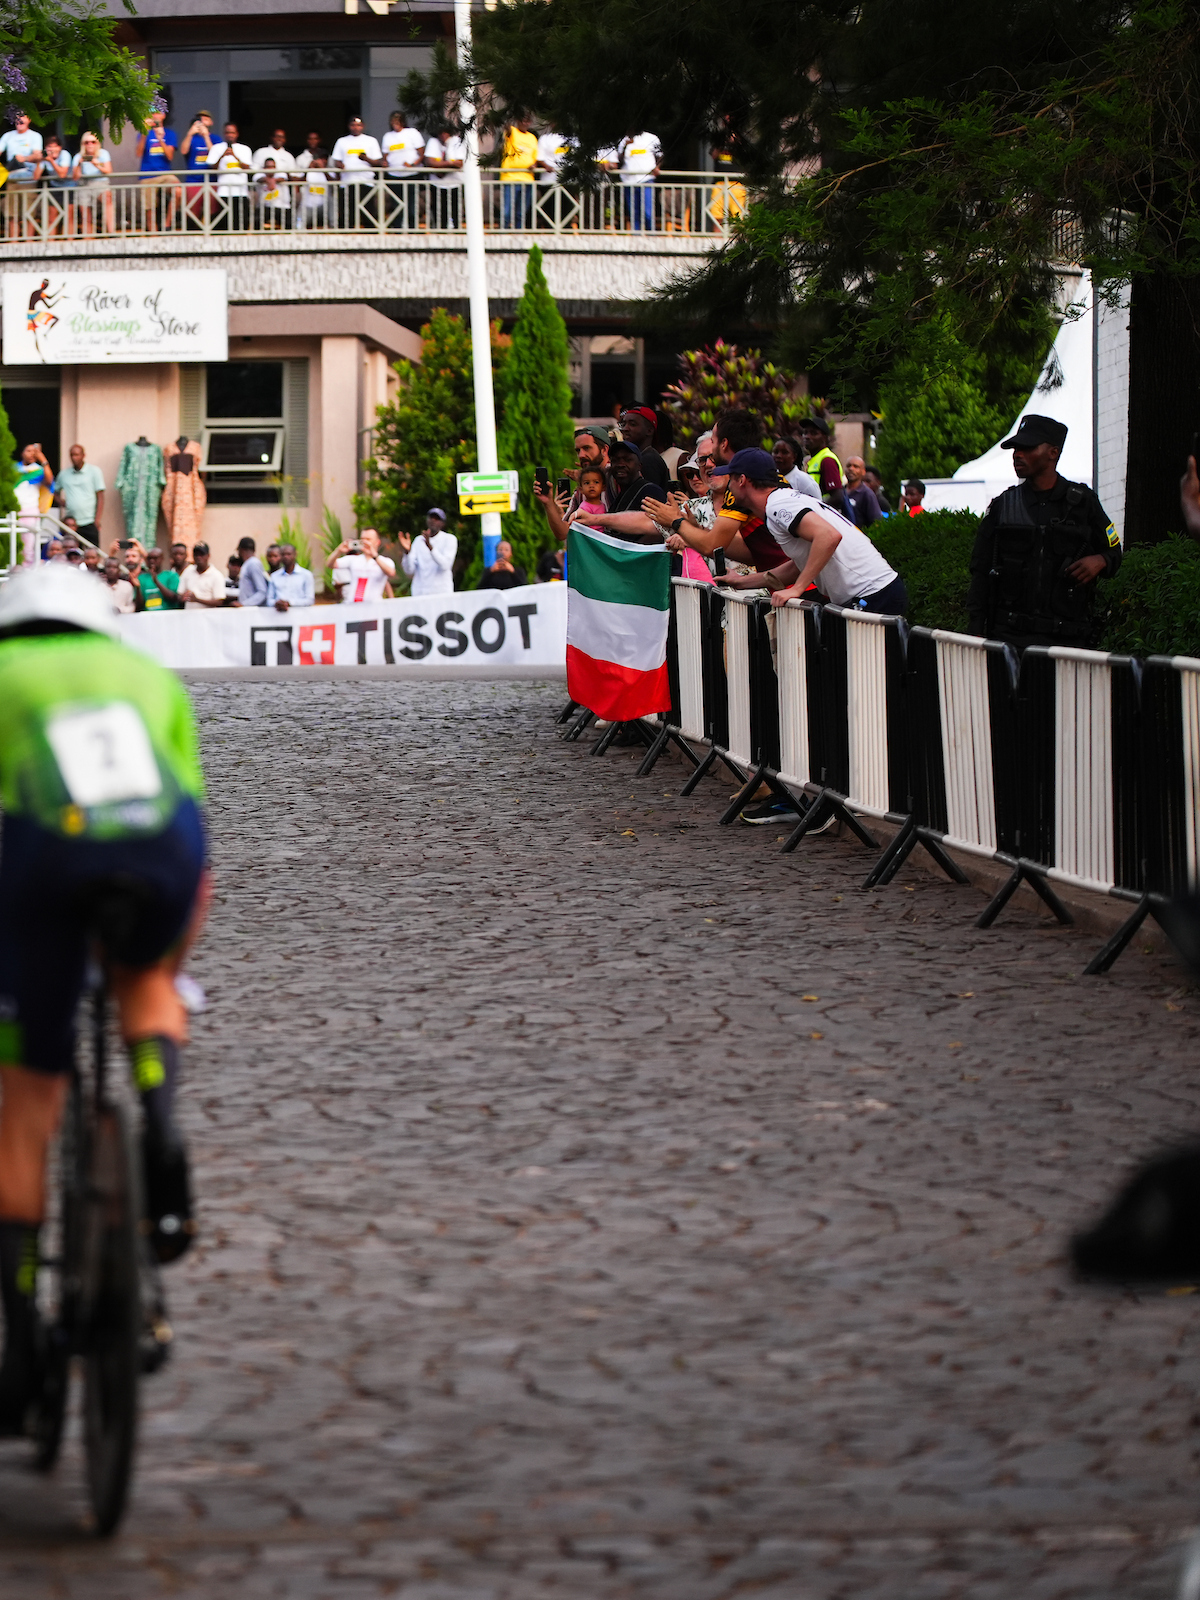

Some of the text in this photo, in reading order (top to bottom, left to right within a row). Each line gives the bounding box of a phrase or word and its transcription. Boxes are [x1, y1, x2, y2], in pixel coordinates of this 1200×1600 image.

[79, 285, 164, 316] River of
[68, 311, 201, 338] Blessings Store
[346, 603, 537, 665] TISSOT
